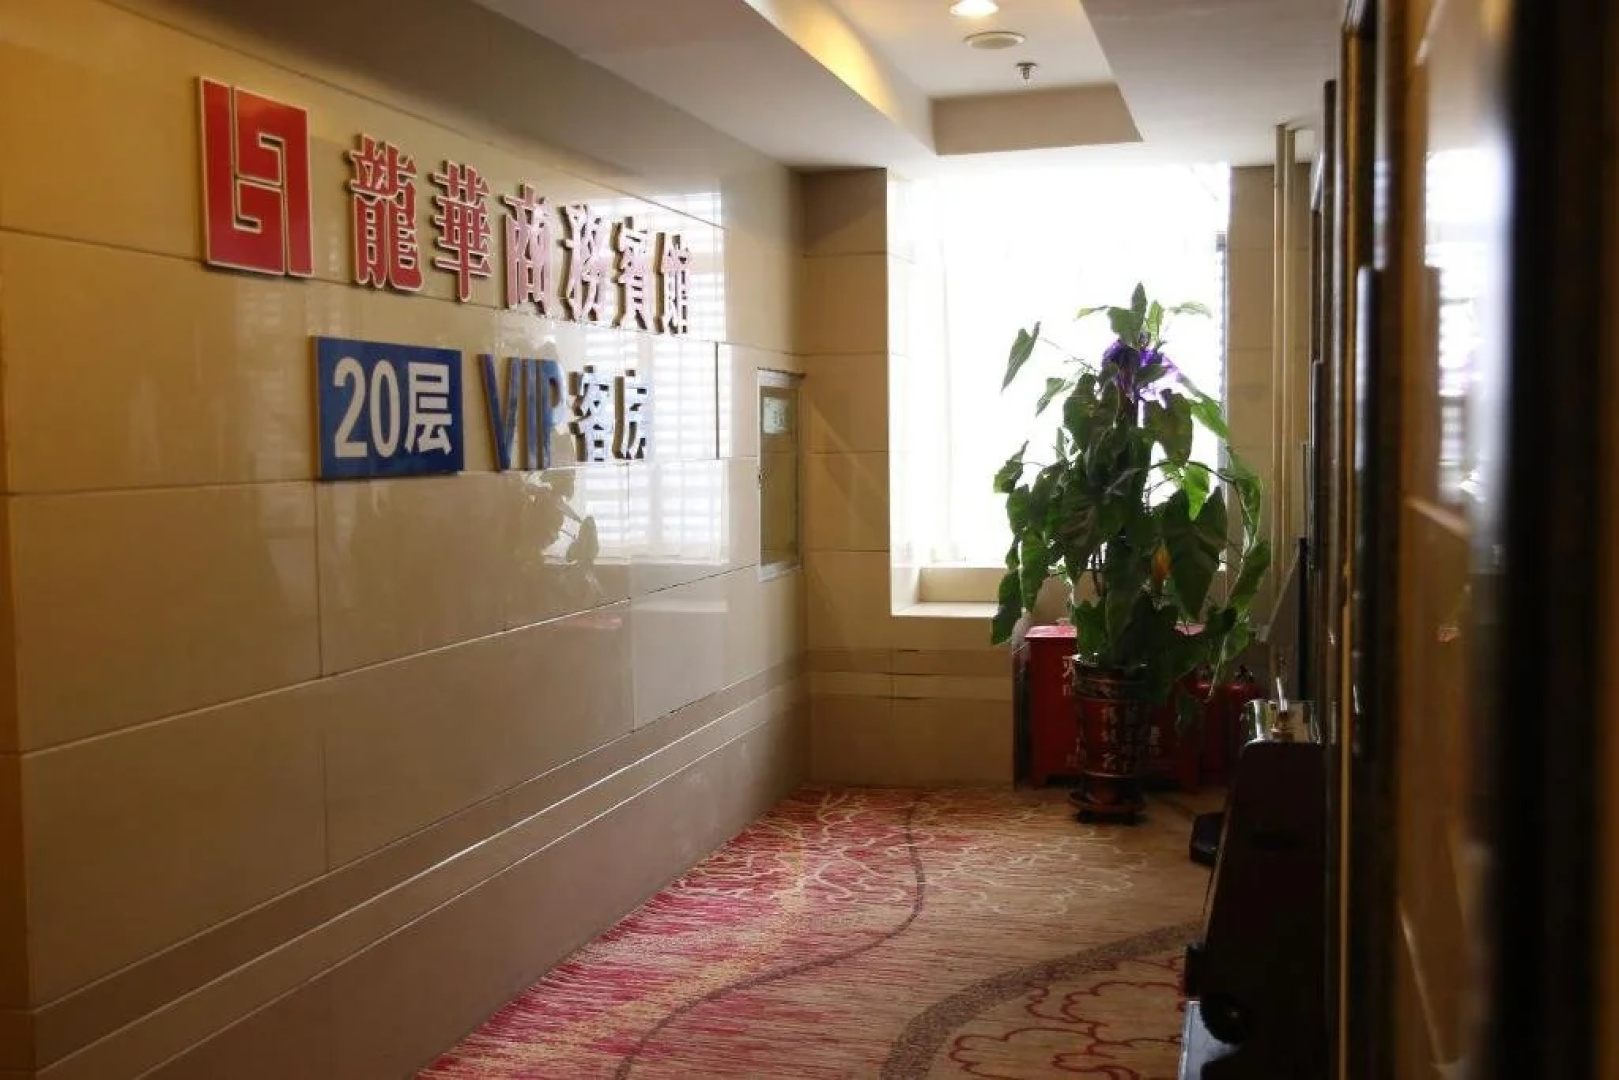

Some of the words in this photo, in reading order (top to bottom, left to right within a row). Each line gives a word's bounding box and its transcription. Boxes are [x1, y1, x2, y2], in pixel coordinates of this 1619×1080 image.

[346, 133, 690, 333] 龍華商務賓館
[333, 356, 453, 458] 20层
